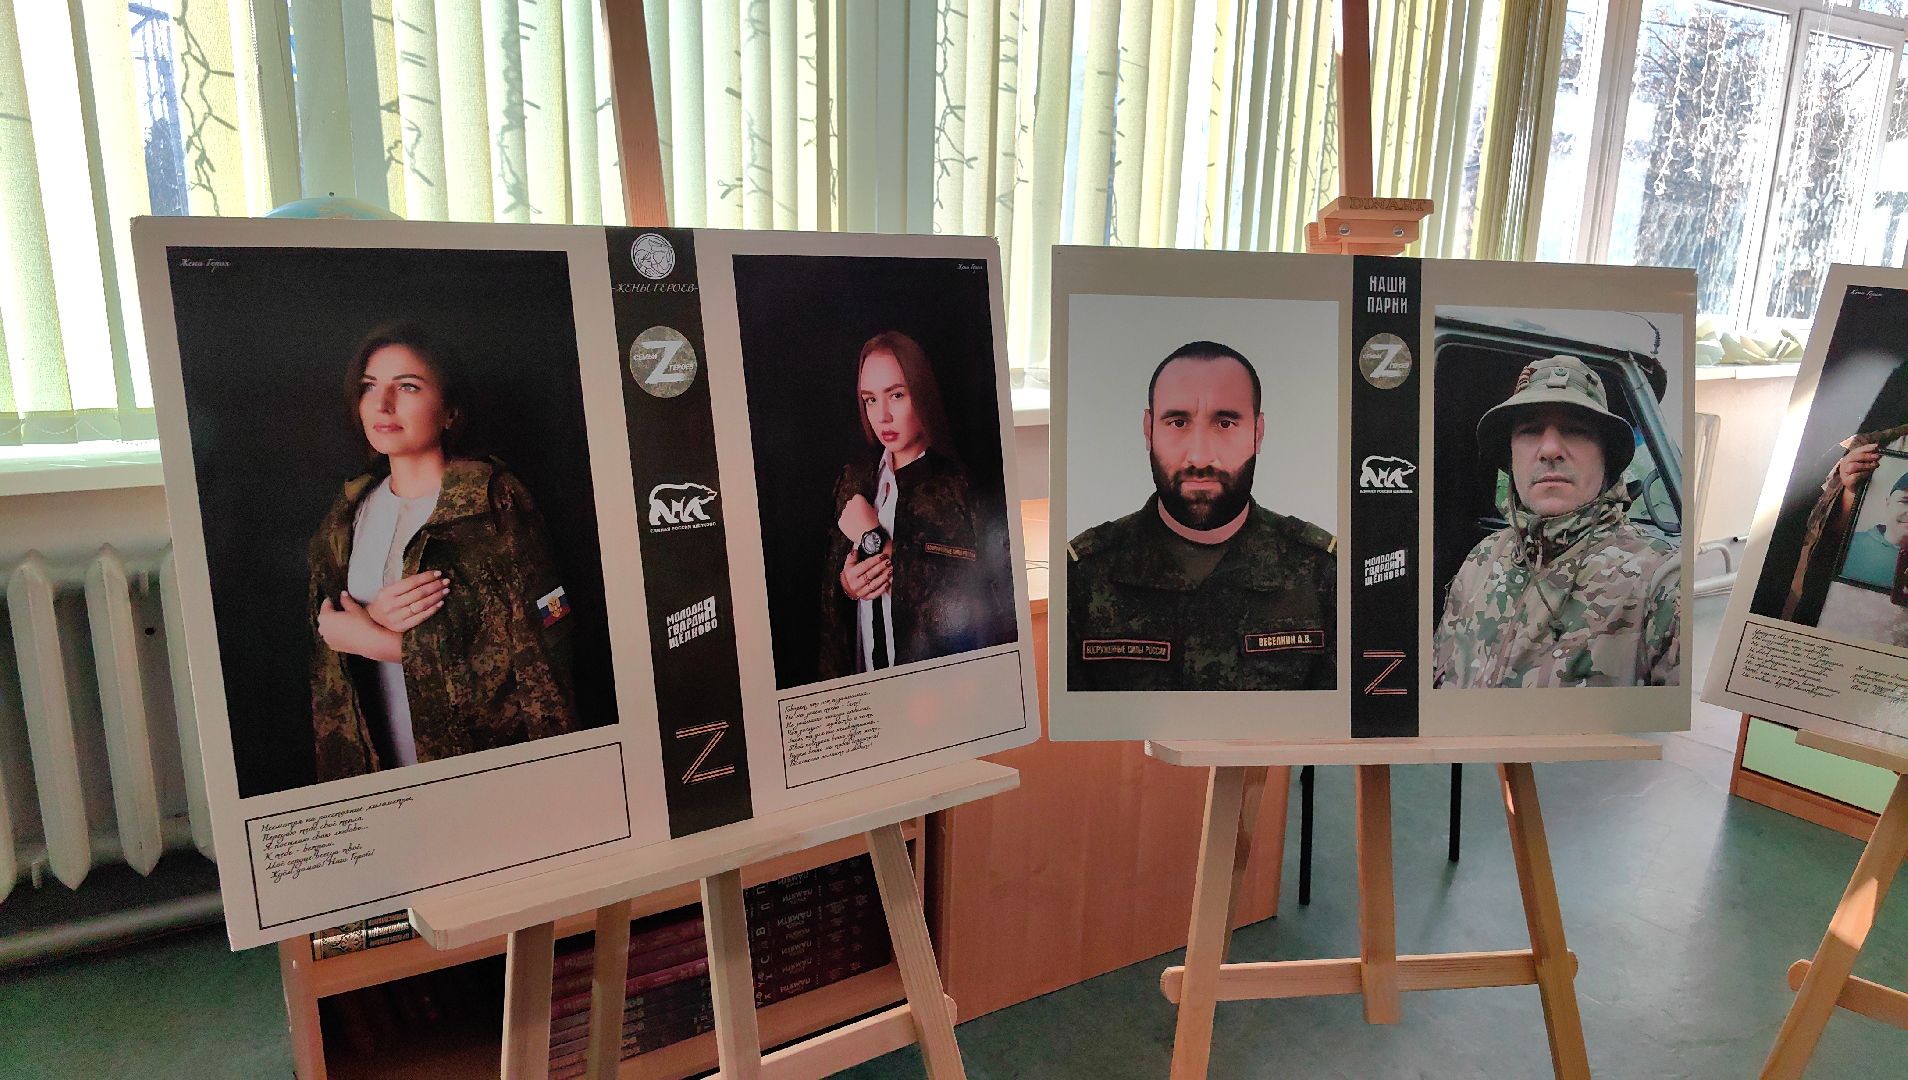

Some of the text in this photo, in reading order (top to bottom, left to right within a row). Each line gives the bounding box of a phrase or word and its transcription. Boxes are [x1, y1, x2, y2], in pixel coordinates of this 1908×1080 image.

[1349, 196, 1426, 212] DINART
[1369, 275, 1406, 293] НАШИ
[1367, 297, 1408, 314] ПАРНИ
[641, 340, 684, 385] Z
[1369, 343, 1403, 378] Z
